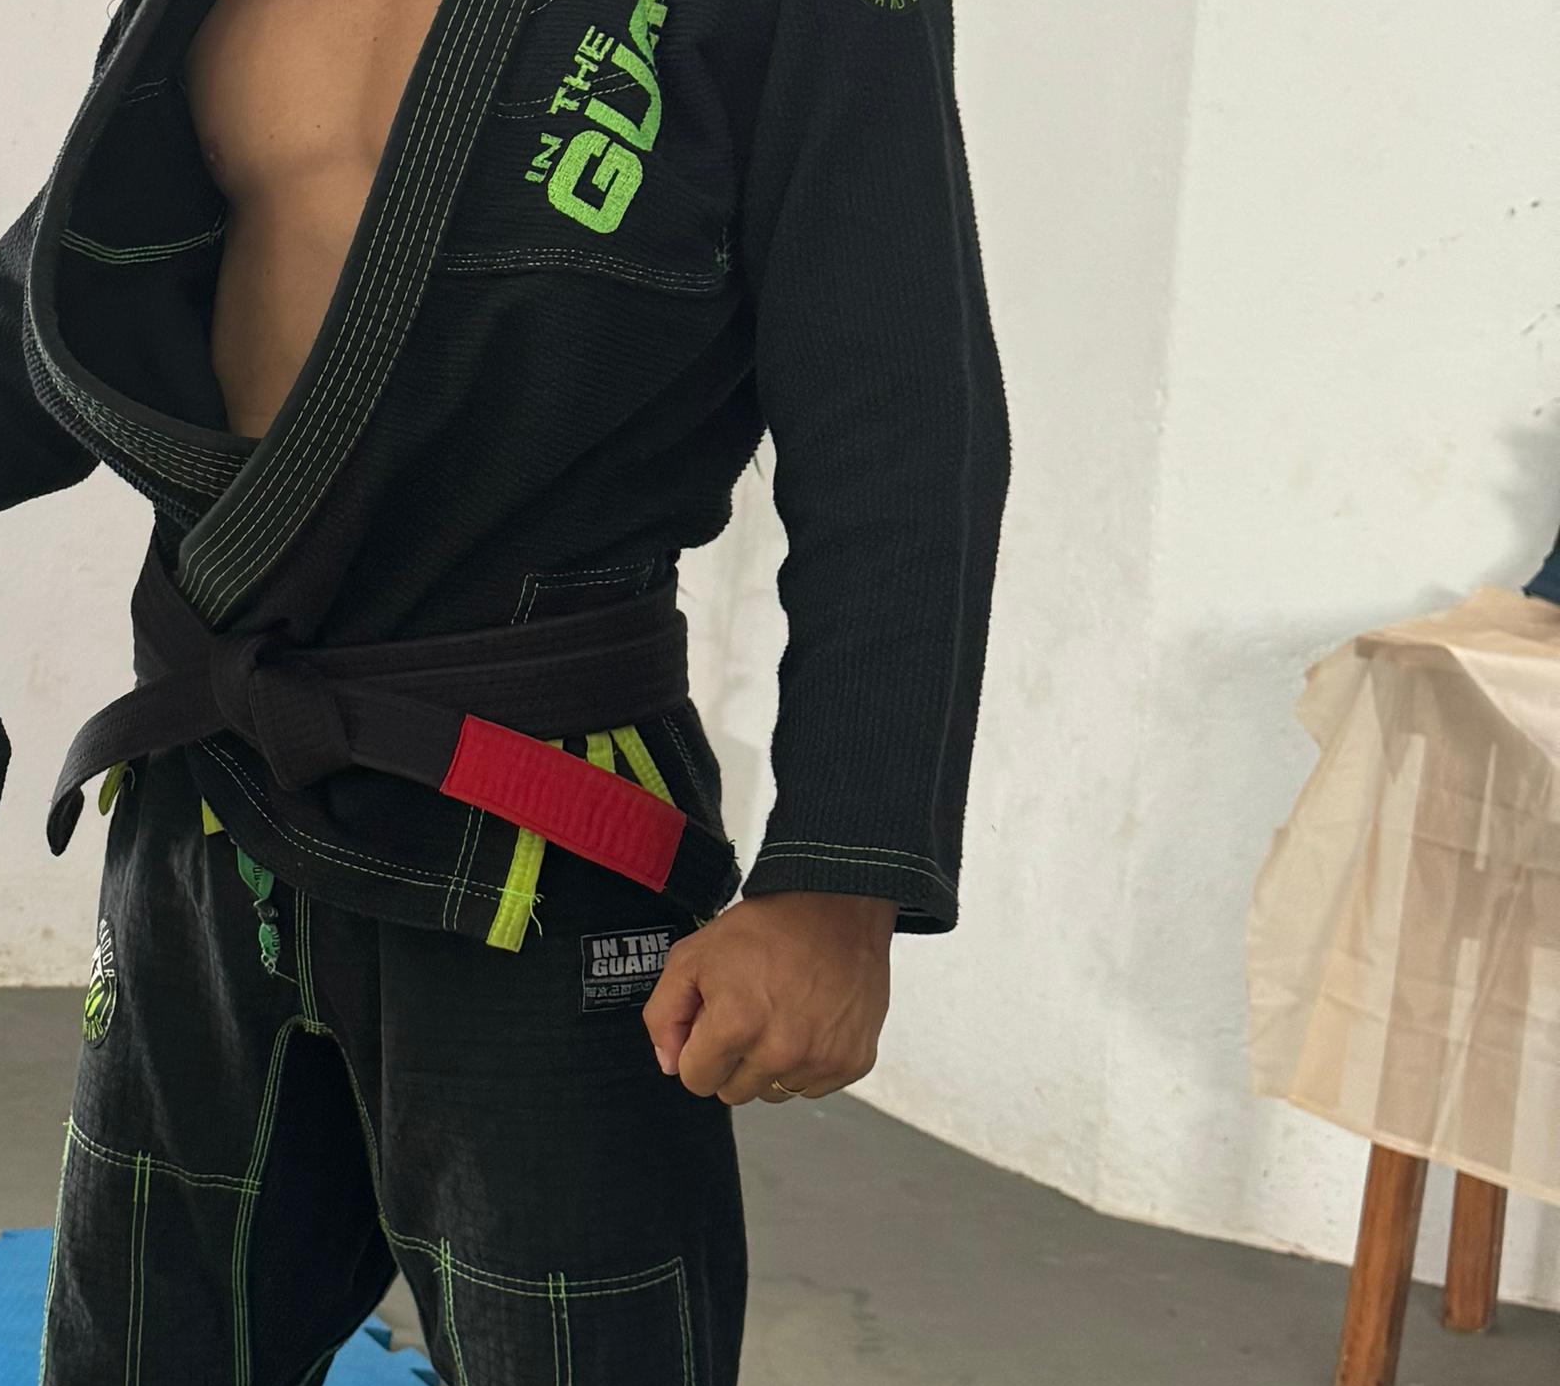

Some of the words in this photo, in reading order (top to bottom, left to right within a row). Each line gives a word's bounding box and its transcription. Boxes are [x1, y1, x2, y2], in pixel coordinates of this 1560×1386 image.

[524, 132, 564, 184] IN
[546, 24, 615, 115] THE
[592, 938, 619, 959] IN
[621, 932, 670, 955] THE
